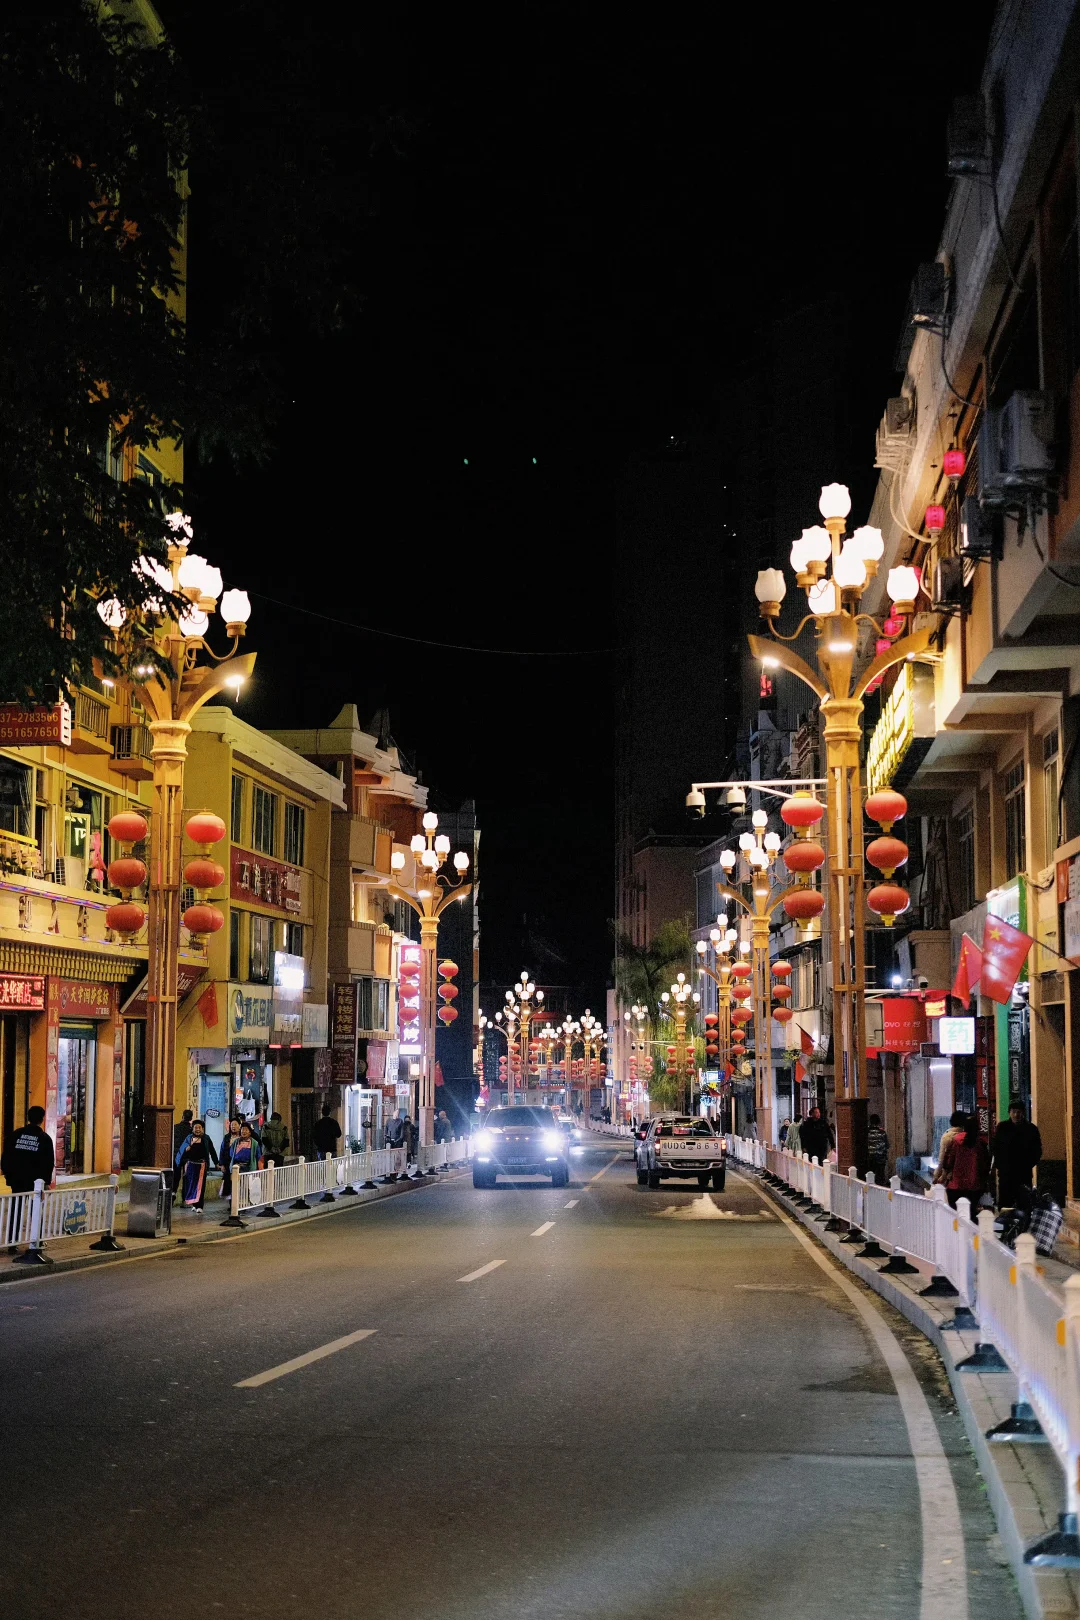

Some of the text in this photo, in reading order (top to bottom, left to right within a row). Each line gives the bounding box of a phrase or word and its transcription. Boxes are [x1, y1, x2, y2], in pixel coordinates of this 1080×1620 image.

[0, 980, 31, 1003] 光华酒店
[946, 1020, 969, 1043] 药
